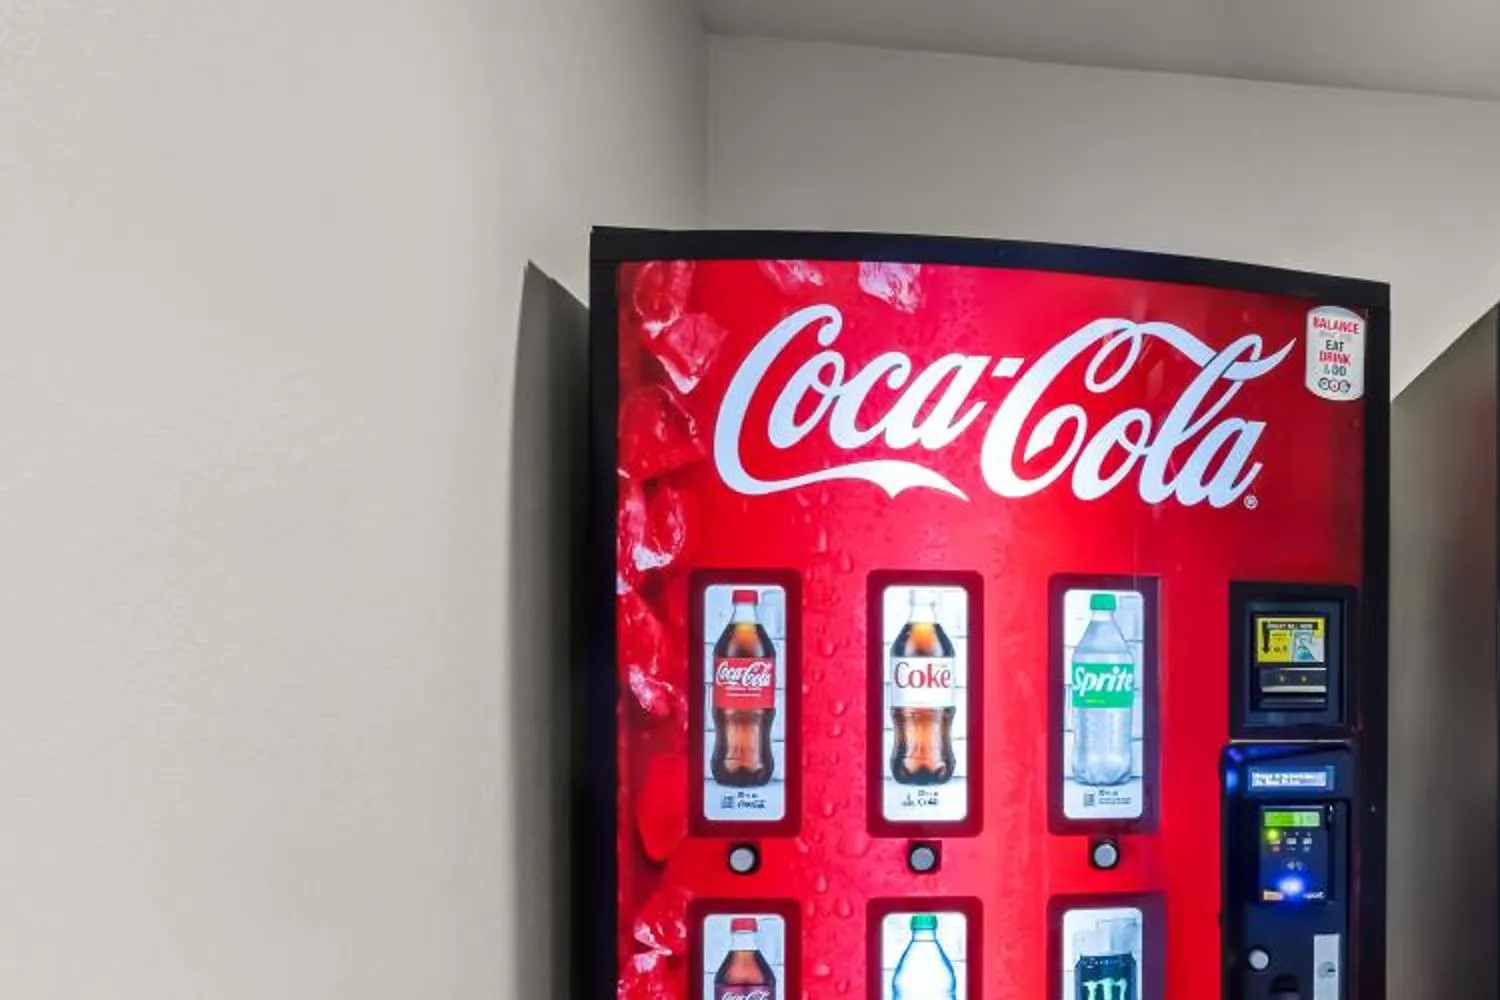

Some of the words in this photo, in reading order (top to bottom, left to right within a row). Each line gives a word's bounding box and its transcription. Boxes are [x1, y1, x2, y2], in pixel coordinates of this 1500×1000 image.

[1312, 315, 1361, 335] BALANCE
[1319, 349, 1351, 366] DRINK
[1325, 339, 1345, 353] EAT
[712, 303, 1296, 508] Coca-Cola
[716, 661, 773, 687] Coca-Cola
[894, 661, 951, 689] Coke
[1072, 665, 1134, 696] Sprite
